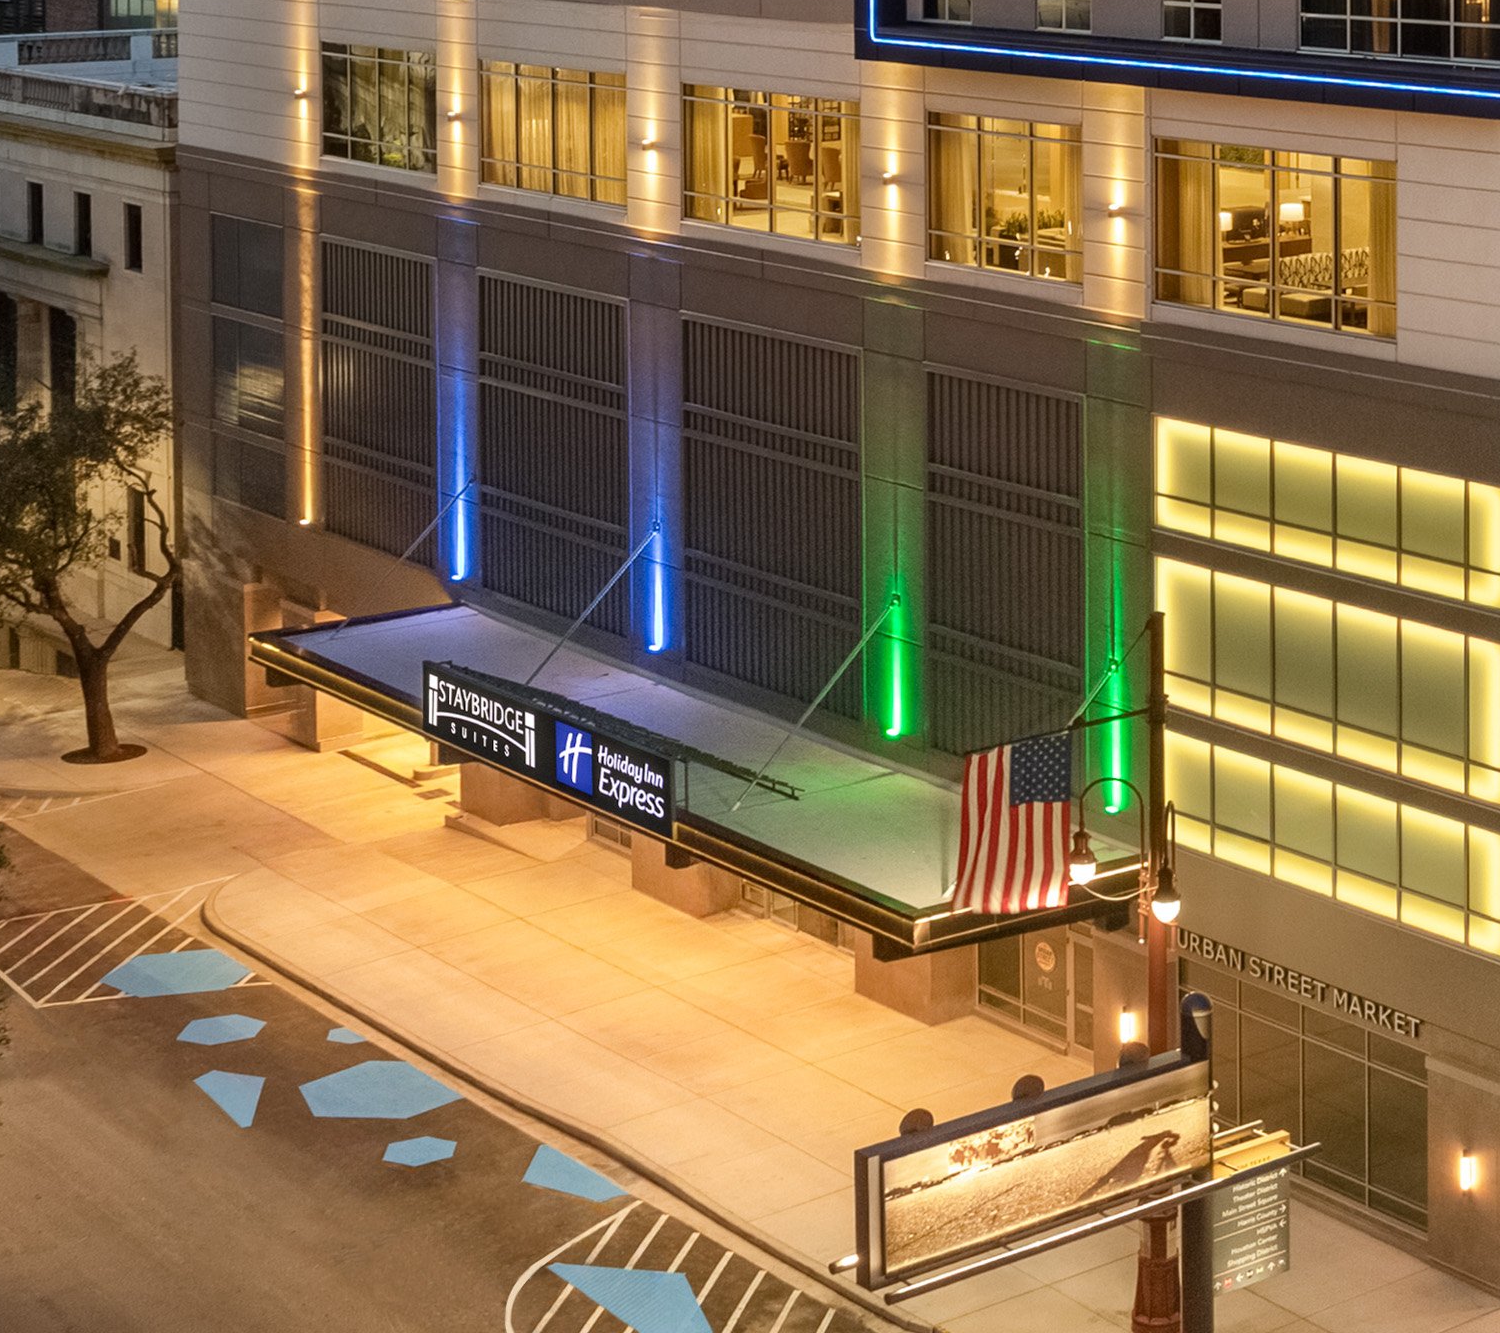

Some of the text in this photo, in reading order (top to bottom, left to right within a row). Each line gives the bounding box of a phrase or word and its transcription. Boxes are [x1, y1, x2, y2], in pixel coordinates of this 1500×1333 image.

[438, 680, 524, 735] STAYBRIDGE
[451, 722, 510, 757] SUITES
[597, 744, 664, 789] Holiday Inn
[598, 768, 665, 818] Express
[1176, 928, 1421, 1039] URBAN STREET MARKET
[1222, 1195, 1278, 1218] Main Street Square
